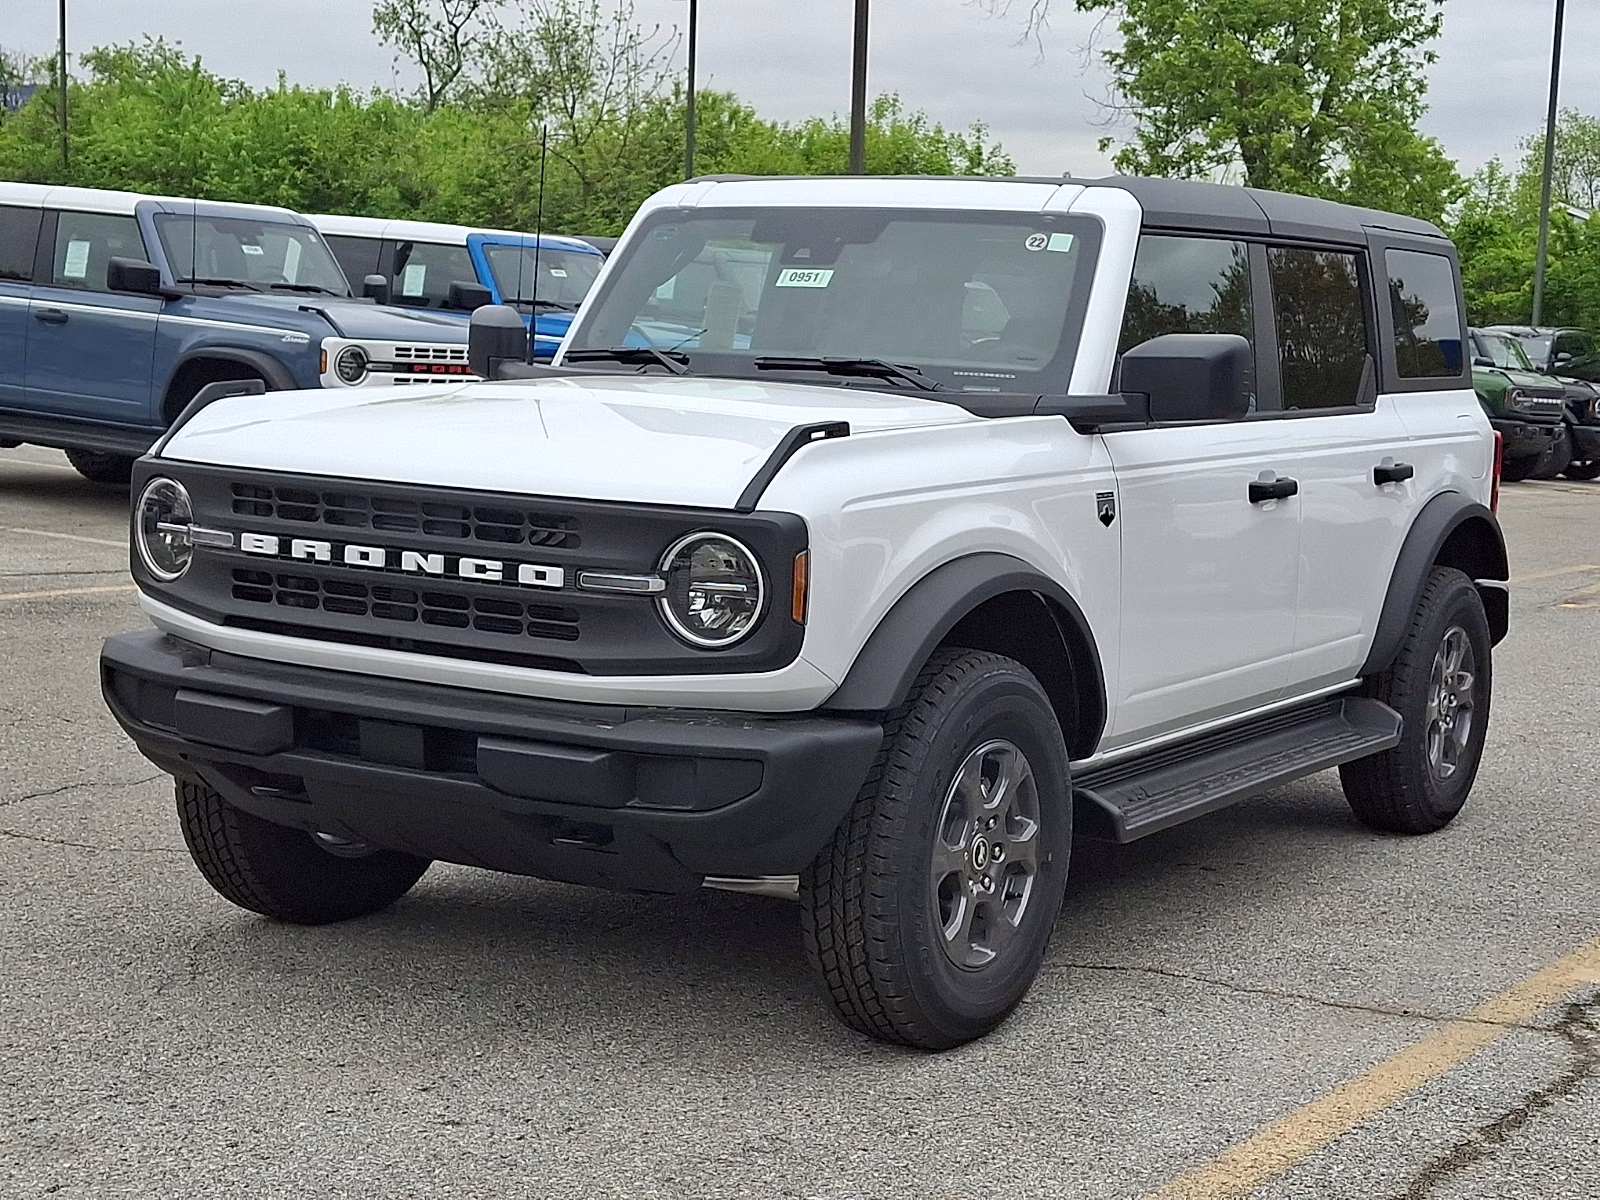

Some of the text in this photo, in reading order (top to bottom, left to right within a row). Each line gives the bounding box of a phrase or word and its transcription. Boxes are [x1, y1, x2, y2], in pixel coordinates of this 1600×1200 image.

[1028, 236, 1045, 248] 22
[789, 271, 820, 283] 0951
[241, 532, 564, 588] BRONCO
